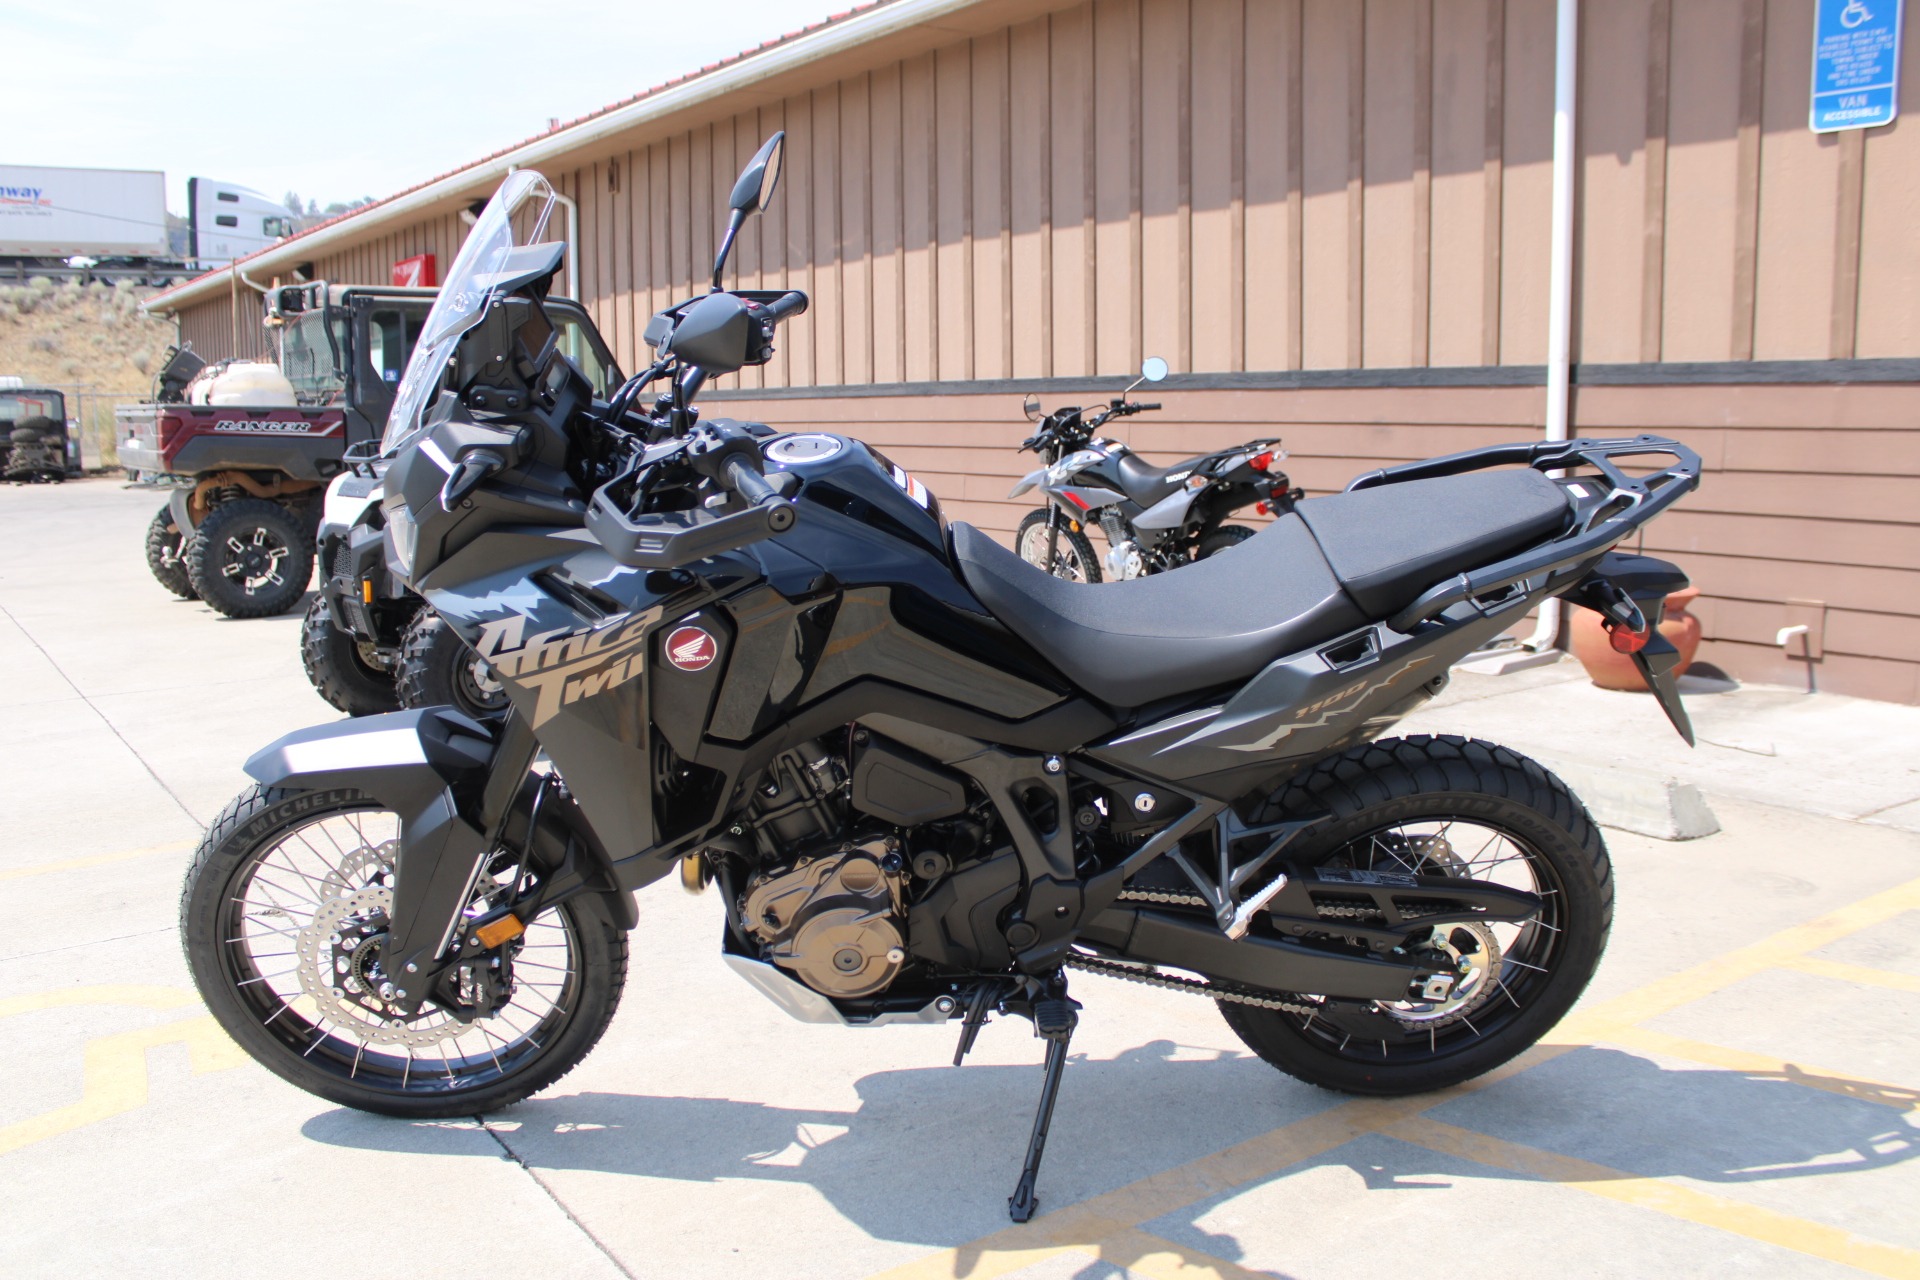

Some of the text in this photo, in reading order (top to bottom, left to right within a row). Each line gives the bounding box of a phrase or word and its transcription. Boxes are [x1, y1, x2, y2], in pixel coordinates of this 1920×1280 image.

[1838, 94, 1868, 109] VAN
[1823, 106, 1882, 122] ACCESSIBLE
[214, 420, 311, 432] RANGER
[1165, 469, 1192, 483] HOND
[476, 605, 664, 678] Africa
[1295, 681, 1368, 718] 1100
[1346, 799, 1495, 831] MICHELIN
